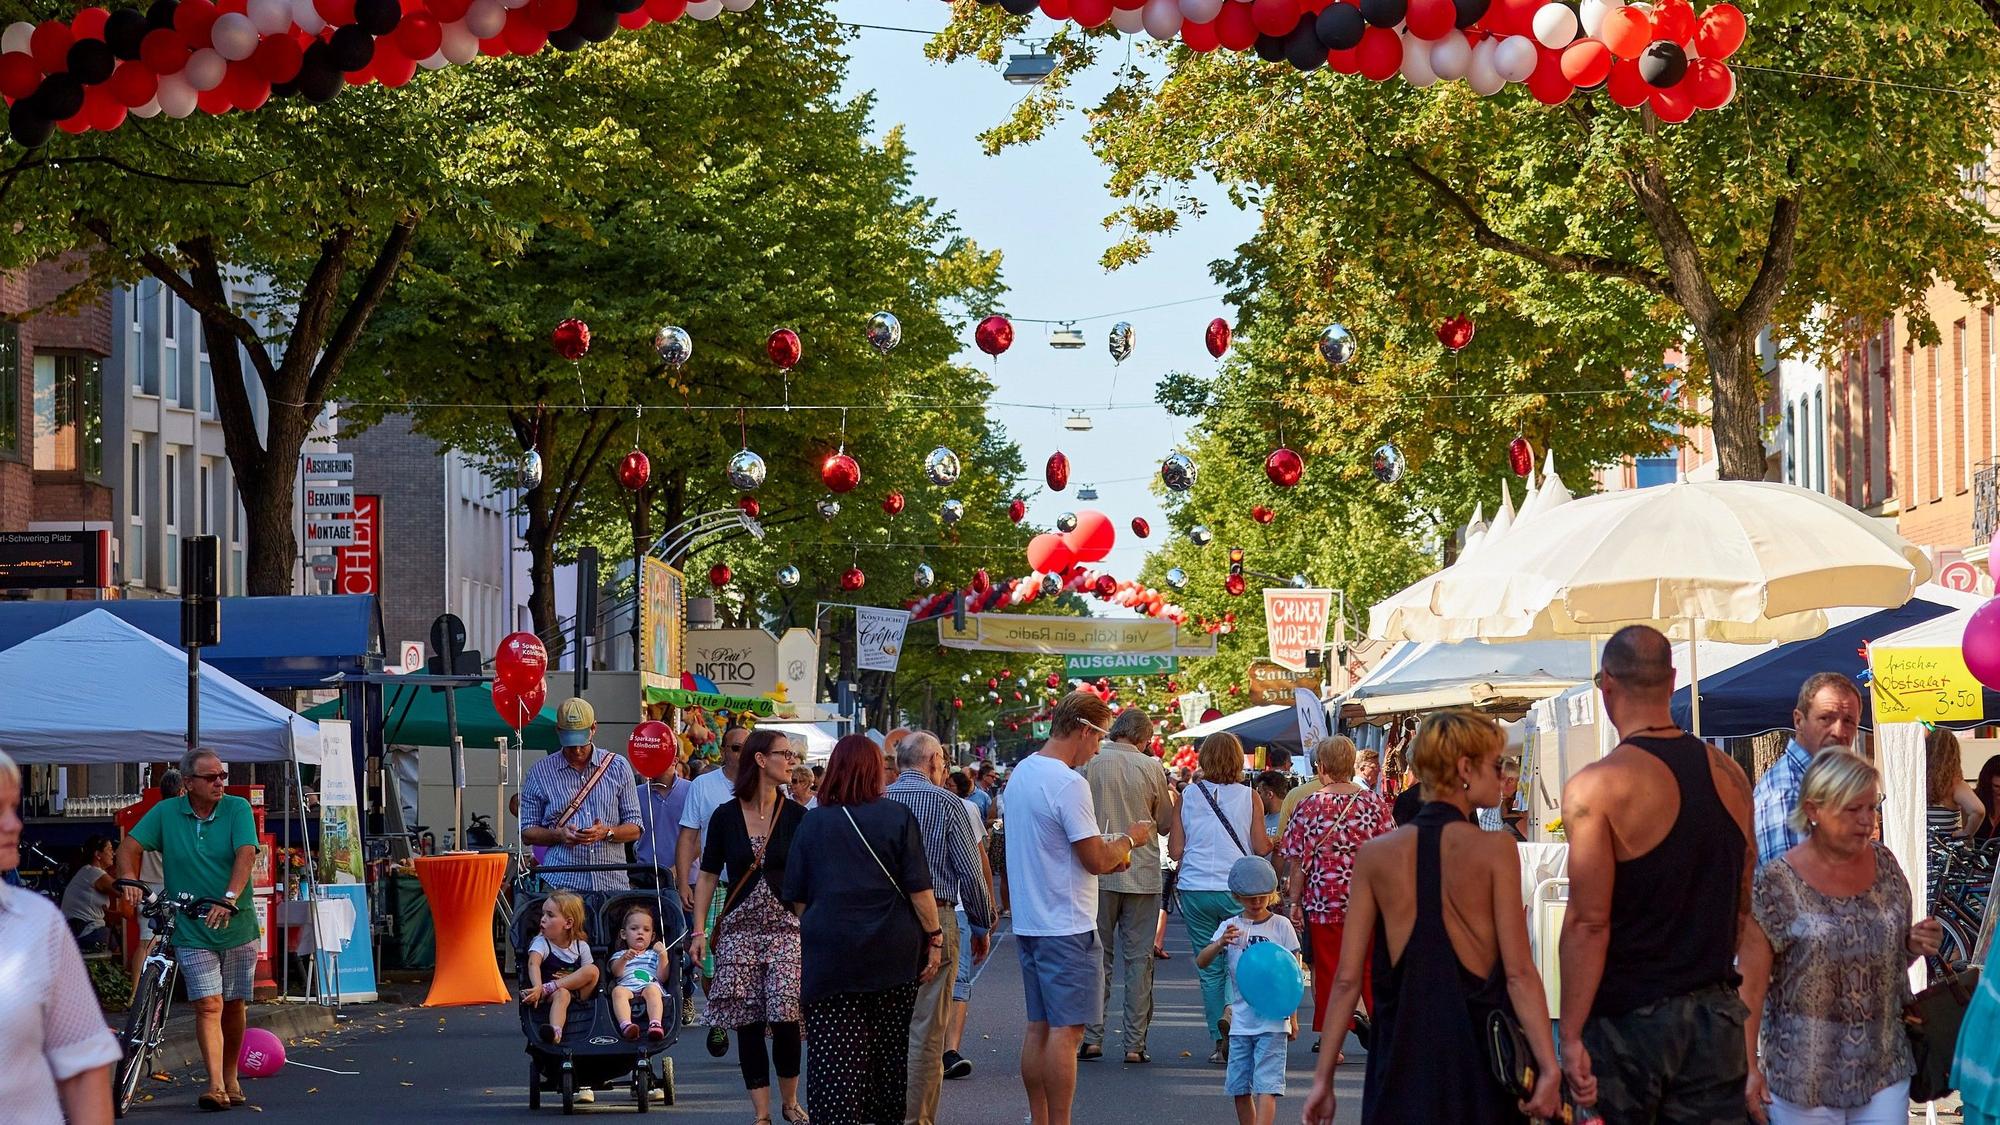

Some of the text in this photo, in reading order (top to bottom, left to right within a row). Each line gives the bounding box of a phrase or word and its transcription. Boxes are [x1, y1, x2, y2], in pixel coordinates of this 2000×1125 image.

[306, 457, 352, 473] ABSICHERUNG
[307, 490, 350, 506] BERATUNG
[51, 534, 72, 542] Platz
[308, 523, 351, 539] MONTAGE
[1273, 600, 1322, 623] CHINA
[1271, 624, 1324, 647] NUDELN
[408, 653, 417, 666] 30
[711, 647, 740, 661] Petit
[1068, 655, 1150, 669] AUSGANG
[695, 662, 755, 681] BISTRO
[1881, 674, 1951, 691] Obstsalat
[685, 693, 718, 708] Little
[724, 696, 754, 711] Duck
[1935, 690, 1976, 715] 3.50
[634, 735, 661, 743] Sparkasse
